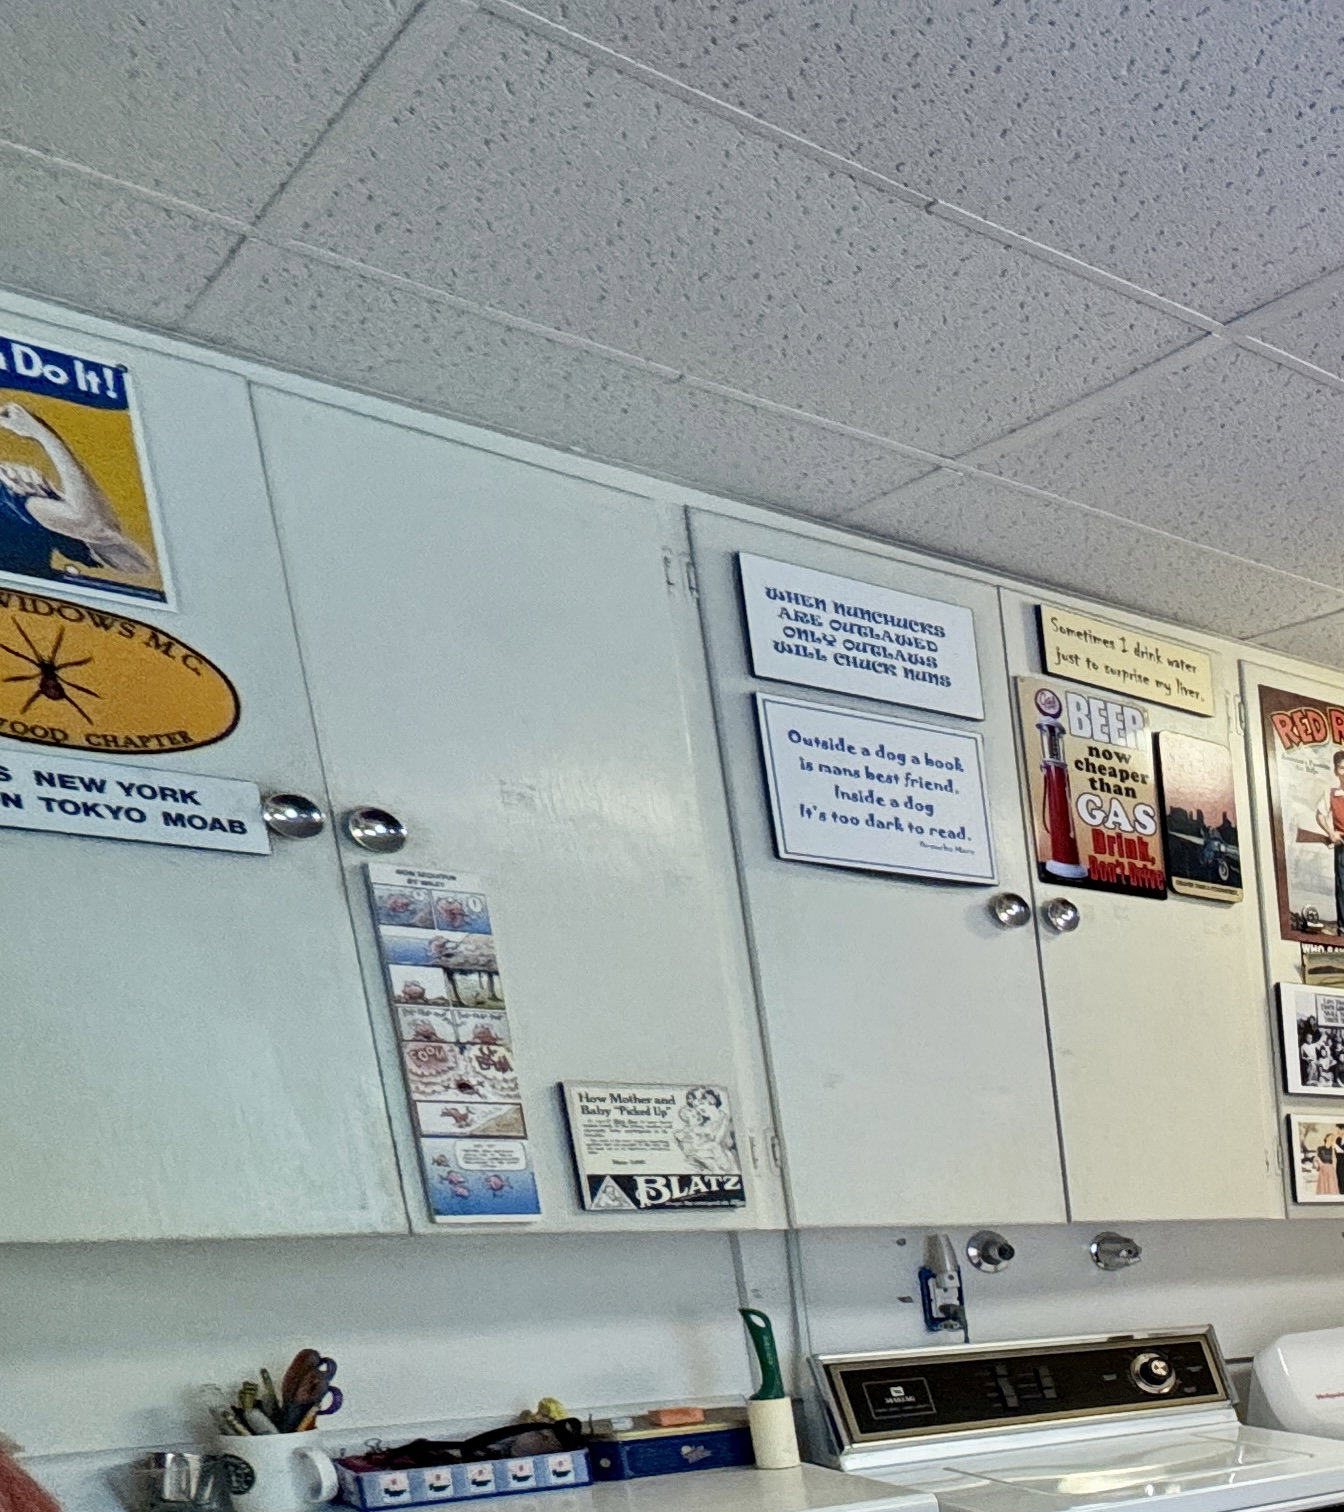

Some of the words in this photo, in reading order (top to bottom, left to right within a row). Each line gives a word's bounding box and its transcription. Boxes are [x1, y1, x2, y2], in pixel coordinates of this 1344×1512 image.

[10, 342, 69, 385] Do
[74, 359, 118, 399] It!
[764, 586, 827, 613] WHEN
[832, 600, 946, 638] NUNCHUCKS
[778, 607, 823, 627] ARE
[829, 619, 938, 652] OUTLAWED
[772, 640, 827, 662] WILL
[833, 652, 897, 677] CHUCK
[903, 666, 952, 688] NUNS
[783, 625, 836, 647] ONLY
[843, 638, 938, 669] OUTLAWS
[1050, 616, 1115, 650] Sometimes
[1119, 637, 1128, 653] I
[1133, 642, 1164, 664] drink
[1167, 656, 1197, 674] water
[1054, 647, 1081, 666] just
[1085, 657, 1098, 671] to
[1104, 664, 1150, 685] surprise
[1155, 680, 1172, 696] my
[1175, 679, 1205, 702] liver.
[85, 730, 194, 750] CHAPTER
[1065, 691, 1146, 750] BEER
[1271, 706, 1330, 749] RED
[788, 729, 857, 755] Outside
[861, 747, 871, 756] a
[875, 744, 906, 766] dog
[911, 755, 920, 764] a
[924, 752, 964, 773] book
[1088, 746, 1132, 765] now
[33, 769, 107, 795] NEW
[116, 780, 202, 806] YORK
[799, 757, 814, 772] is
[818, 762, 861, 779] mans
[865, 766, 900, 785] best
[904, 772, 960, 795] friend.
[1074, 758, 1149, 785] cheaper
[1089, 777, 1138, 799] than
[37, 795, 147, 824] TOKYO
[162, 810, 248, 836] MOAB
[834, 785, 886, 807] Inside
[890, 798, 900, 808] a
[904, 796, 934, 817] dog
[1077, 792, 1157, 836] GAS
[799, 803, 827, 823] It's
[831, 812, 860, 826] too
[865, 814, 904, 833] dark
[908, 822, 925, 836] to
[929, 826, 973, 841] read.
[1091, 829, 1156, 866] Drink,
[1088, 854, 1128, 885] Don't
[1129, 864, 1165, 891] Drive
[579, 1092, 606, 1104] How
[609, 1093, 651, 1105] Mother
[654, 1095, 677, 1105] and
[581, 1106, 612, 1118] Baby
